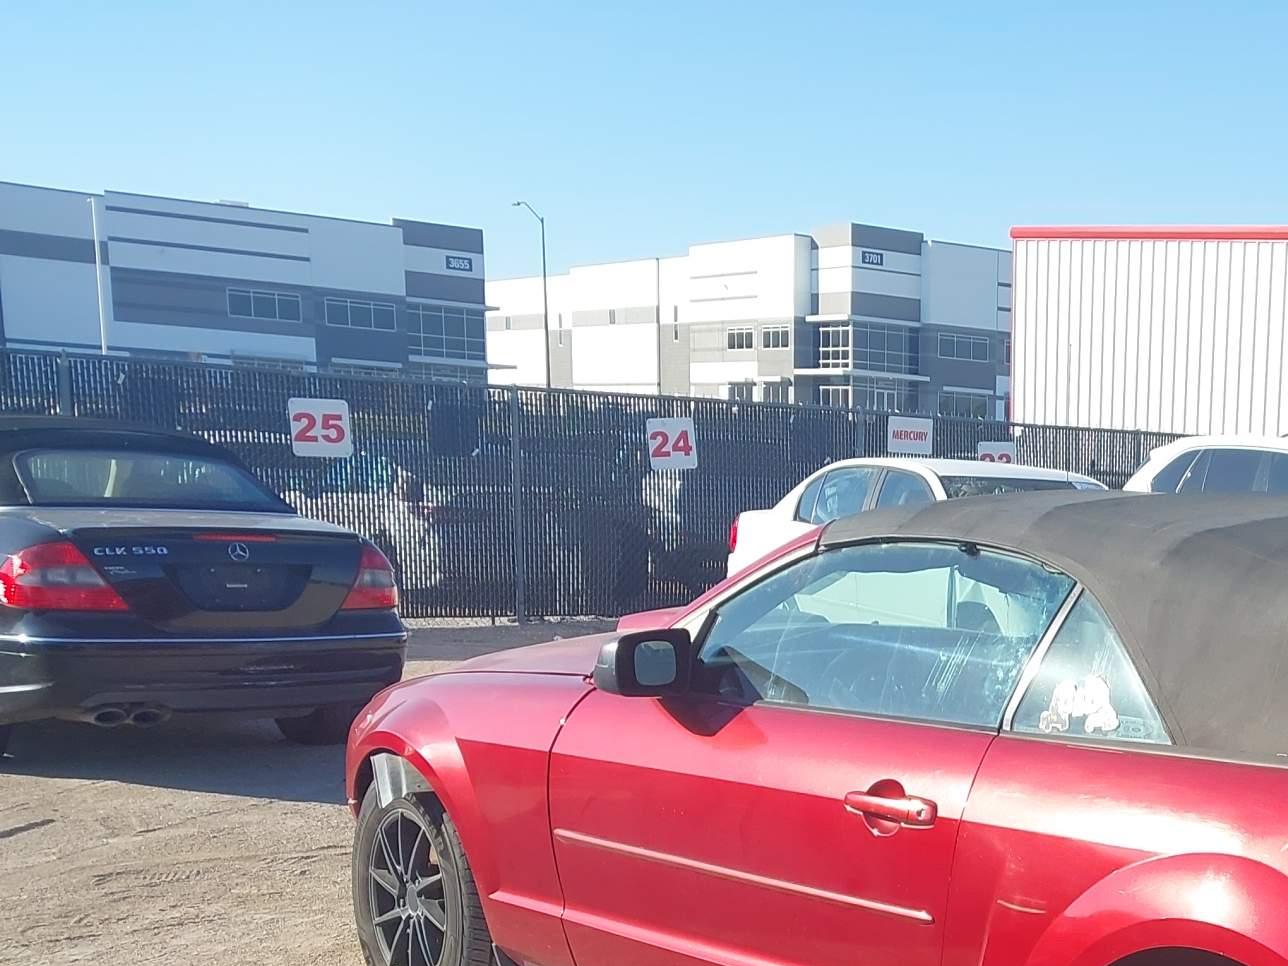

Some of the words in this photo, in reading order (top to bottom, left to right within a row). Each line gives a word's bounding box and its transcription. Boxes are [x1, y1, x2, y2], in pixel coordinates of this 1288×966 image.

[864, 252, 881, 265] 3701
[292, 411, 346, 444] 25
[891, 429, 928, 442] MERCURY
[649, 429, 693, 458] 24
[93, 546, 127, 556] CLK
[132, 545, 169, 555] 550
